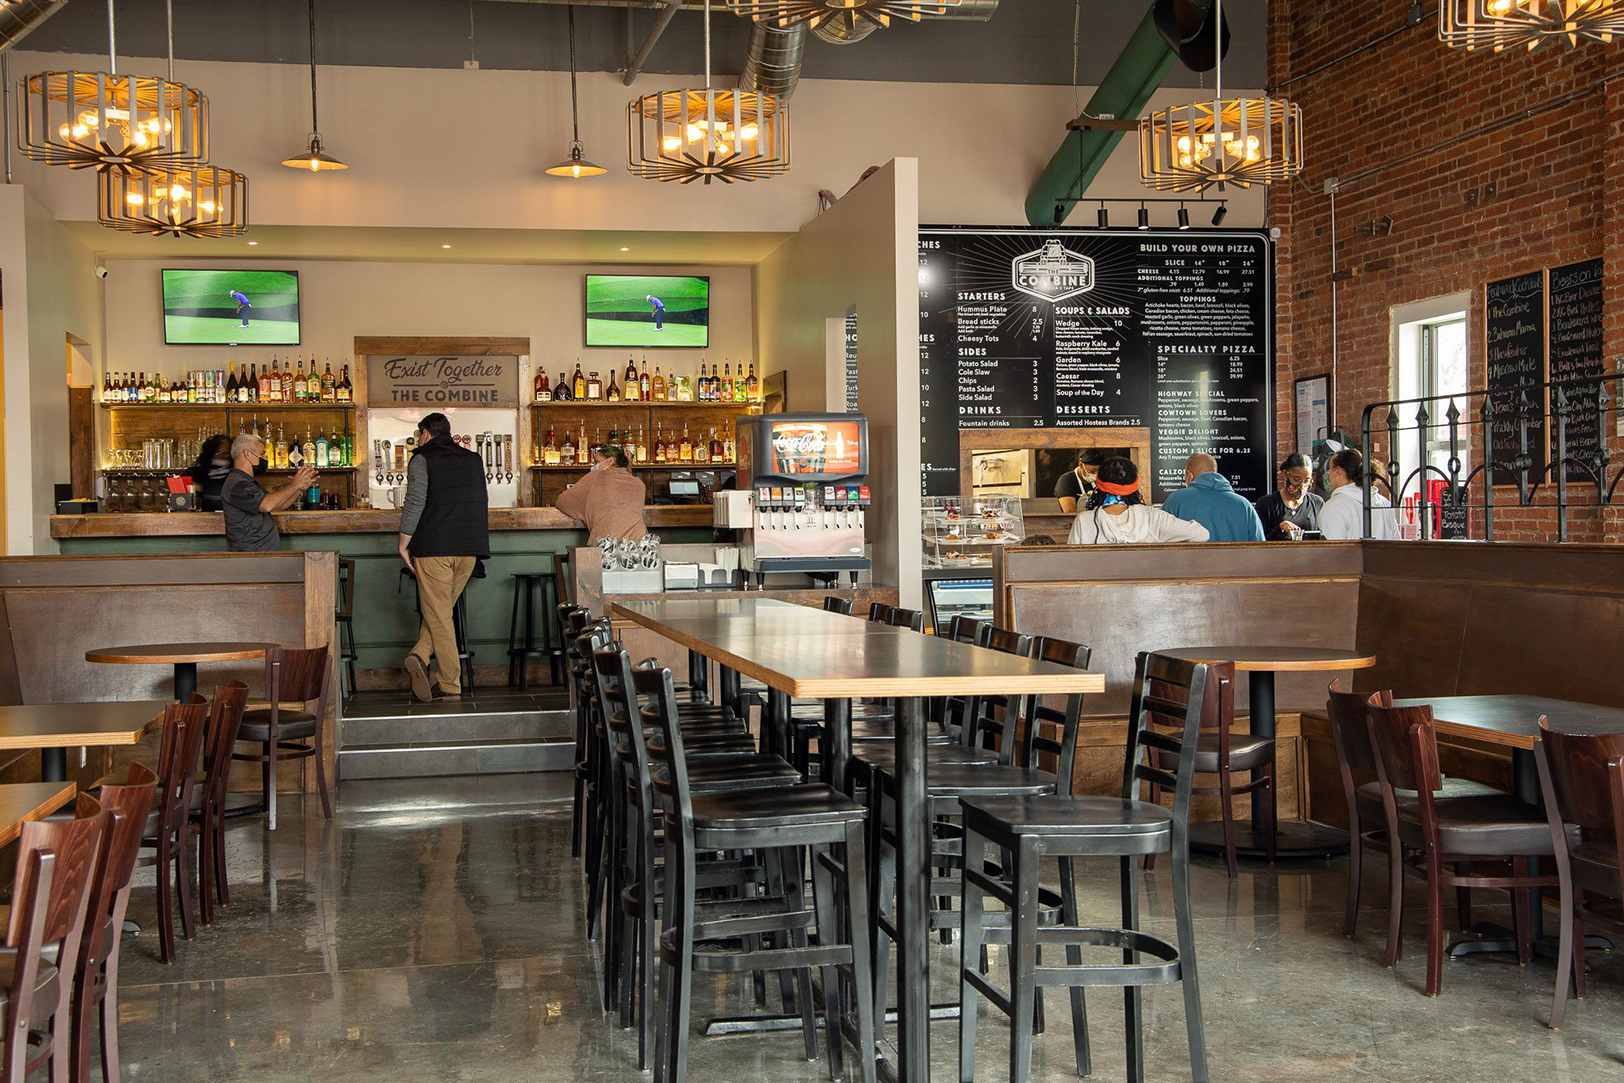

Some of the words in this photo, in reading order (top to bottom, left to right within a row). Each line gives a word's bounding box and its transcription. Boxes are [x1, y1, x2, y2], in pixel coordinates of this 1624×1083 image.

[1140, 244, 1168, 252] BUILD
[1228, 245, 1255, 253] PIZZA
[1552, 272, 1577, 289] Beers
[1055, 307, 1084, 315] SOUPS
[1096, 307, 1130, 315] SALADS
[1502, 302, 1530, 317] Combine
[958, 335, 983, 343] Cheesy
[958, 348, 987, 356] SIDES
[384, 358, 432, 379] Exist
[433, 358, 503, 383] Together
[958, 377, 977, 385] Chips
[391, 390, 419, 401] THE
[425, 390, 498, 401] COMBINE
[1057, 389, 1073, 397] Soup
[1091, 389, 1104, 397] Day
[776, 433, 826, 452] Coca-Cola
